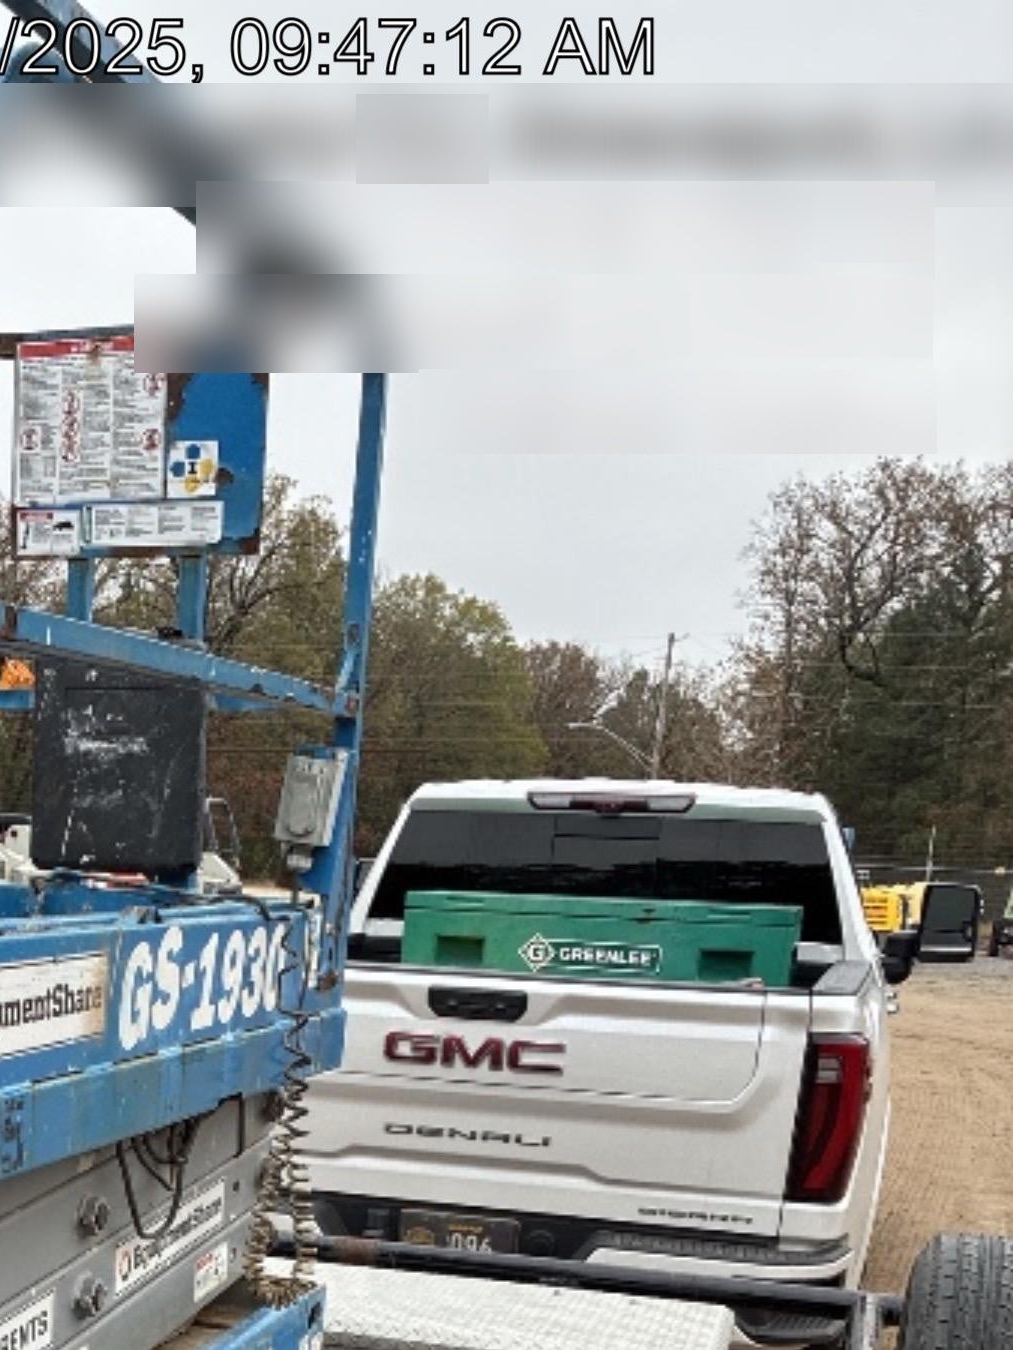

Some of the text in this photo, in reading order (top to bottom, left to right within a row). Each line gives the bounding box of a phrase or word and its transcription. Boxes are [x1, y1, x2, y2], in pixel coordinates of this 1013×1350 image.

[559, 946, 652, 967] GREENLEE
[118, 922, 286, 1051] GS-1930
[383, 1031, 567, 1077] GMC
[383, 1121, 553, 1148] DENALI
